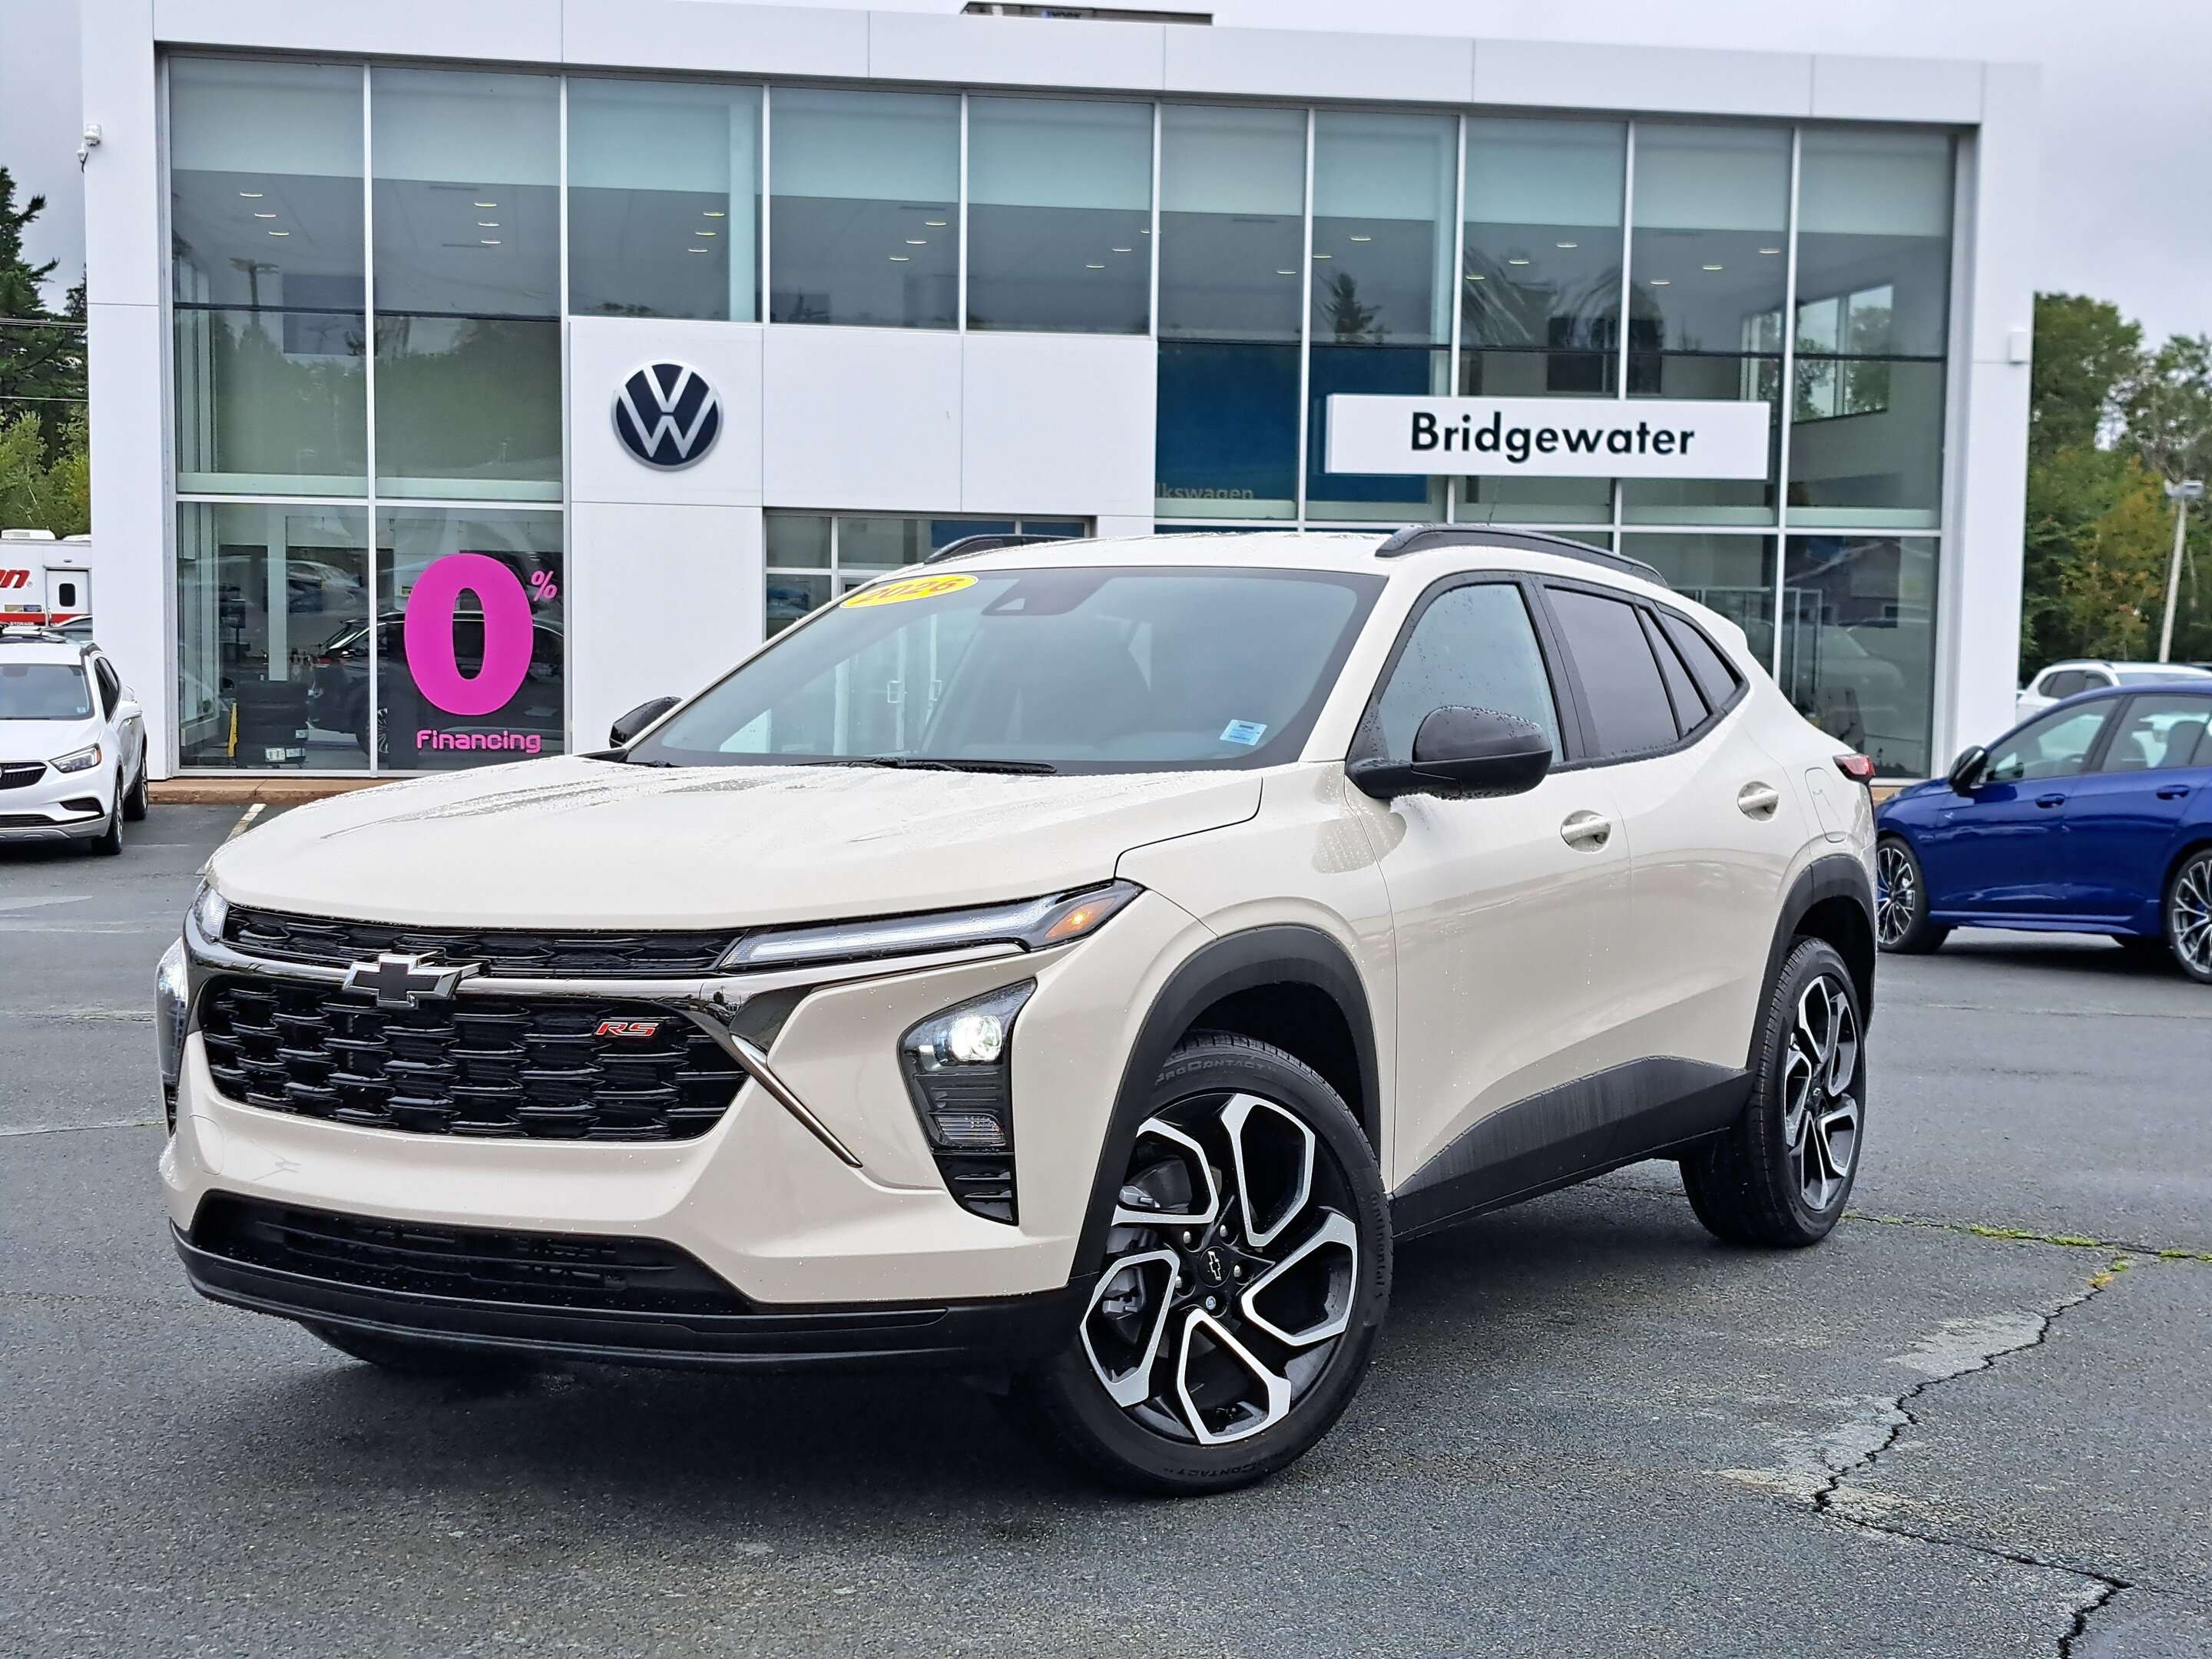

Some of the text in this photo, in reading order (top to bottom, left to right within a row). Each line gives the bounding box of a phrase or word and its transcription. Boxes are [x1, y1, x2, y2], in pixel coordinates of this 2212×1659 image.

[1411, 411, 1695, 464] Bridgewater
[416, 730, 541, 753] Financing
[595, 1022, 659, 1036] RS
